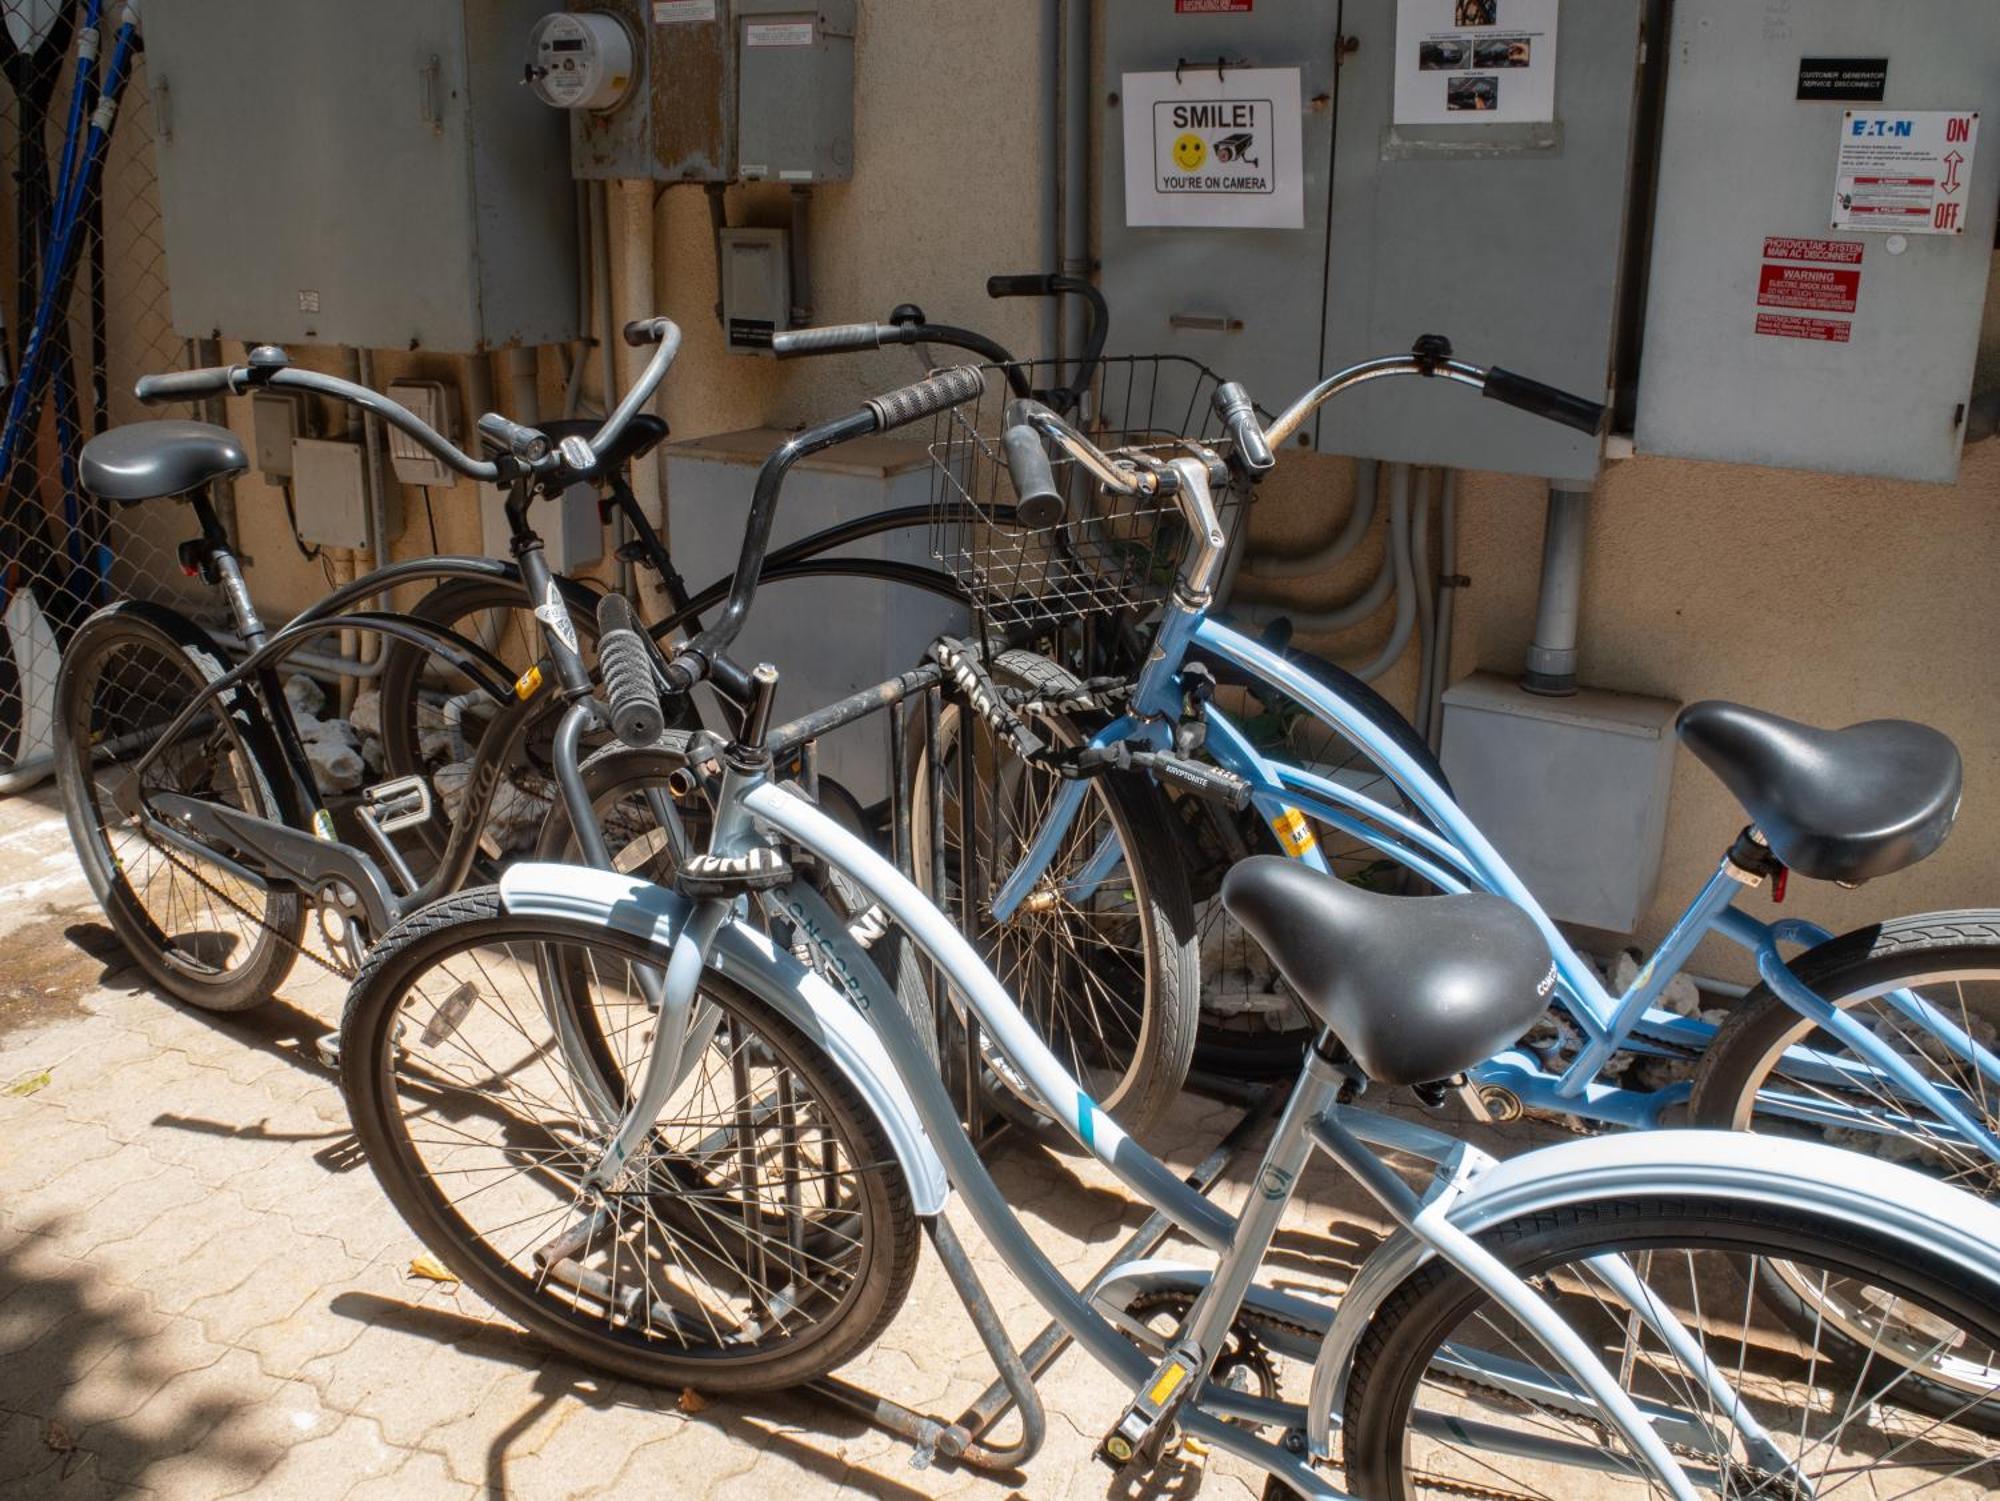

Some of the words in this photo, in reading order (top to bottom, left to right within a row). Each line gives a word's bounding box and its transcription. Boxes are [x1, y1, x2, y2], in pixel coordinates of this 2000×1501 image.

[1173, 105, 1254, 128] SMILE!
[1946, 118, 1970, 142] ON
[1163, 177, 1202, 189] YOU'RE
[1205, 177, 1220, 189] ON
[1223, 177, 1266, 189] CAMERA
[1934, 203, 1960, 229] OFF
[1764, 239, 1827, 251] PHOTOVOLTAIC
[1828, 243, 1863, 253] SYSTEM
[1790, 249, 1802, 258] AC
[1804, 250, 1858, 262] DISCONNECT
[1783, 269, 1835, 282] WARNING
[1166, 765, 1209, 786] KRYPTONITE
[774, 887, 870, 1011] CONCORD
